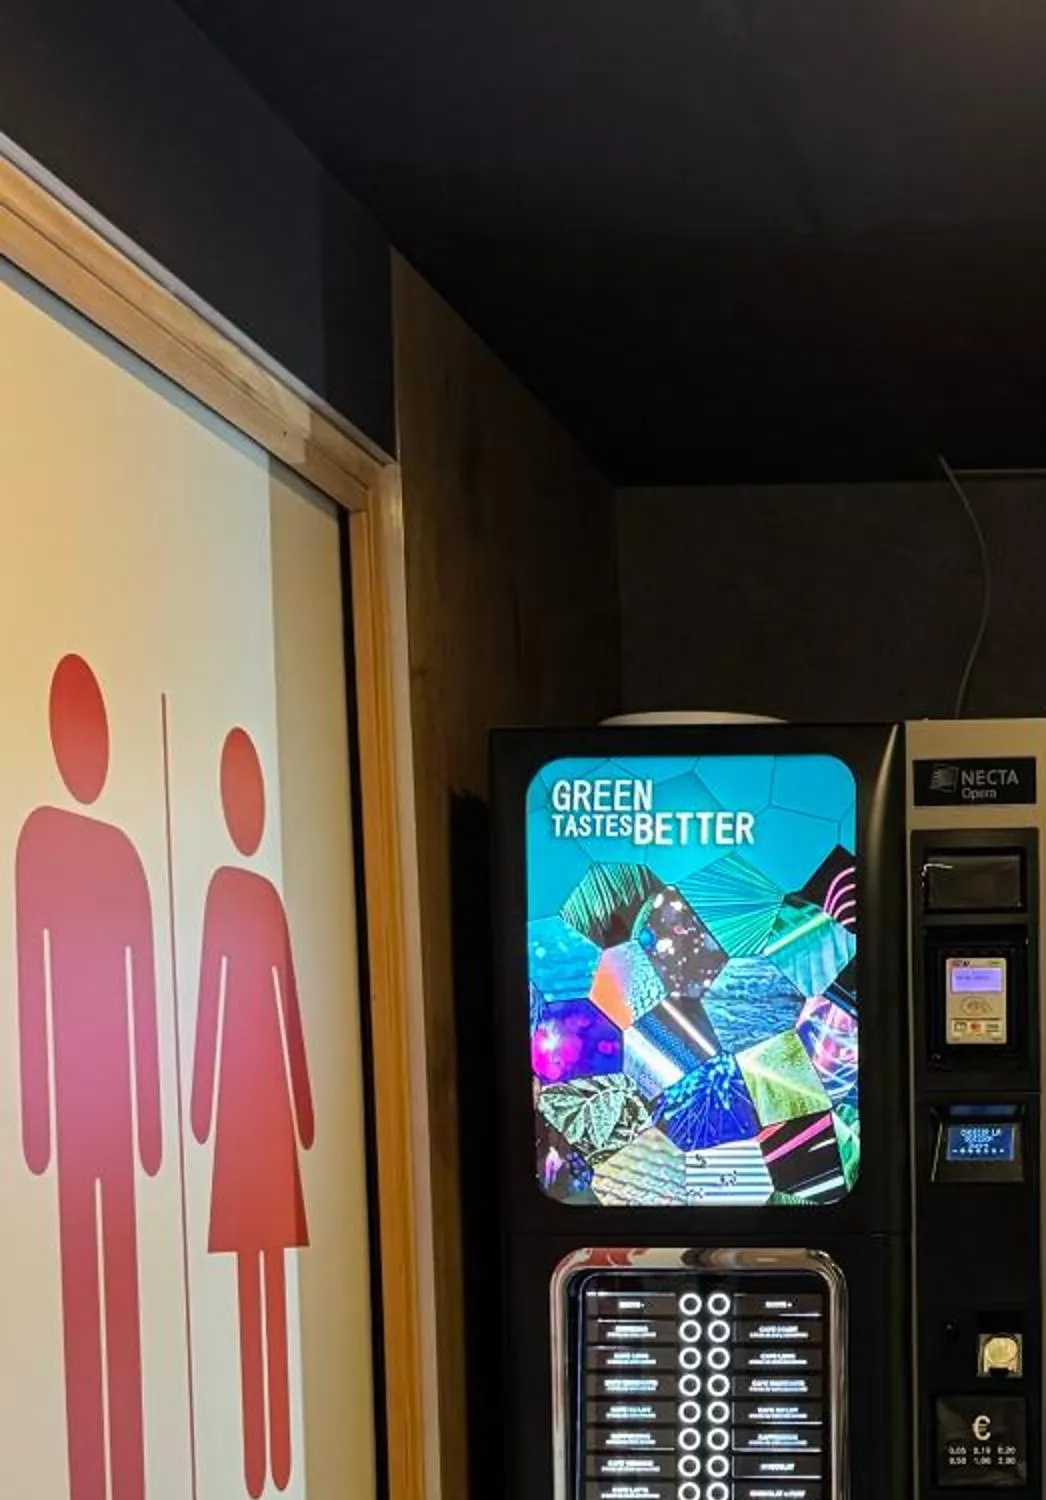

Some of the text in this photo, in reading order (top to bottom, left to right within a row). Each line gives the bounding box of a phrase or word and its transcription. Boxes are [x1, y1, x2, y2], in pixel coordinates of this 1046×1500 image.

[961, 769, 1019, 785] NECTA
[552, 779, 653, 812] GREEN
[552, 811, 755, 846] TASTES BETTER
[972, 1415, 991, 1441] €
